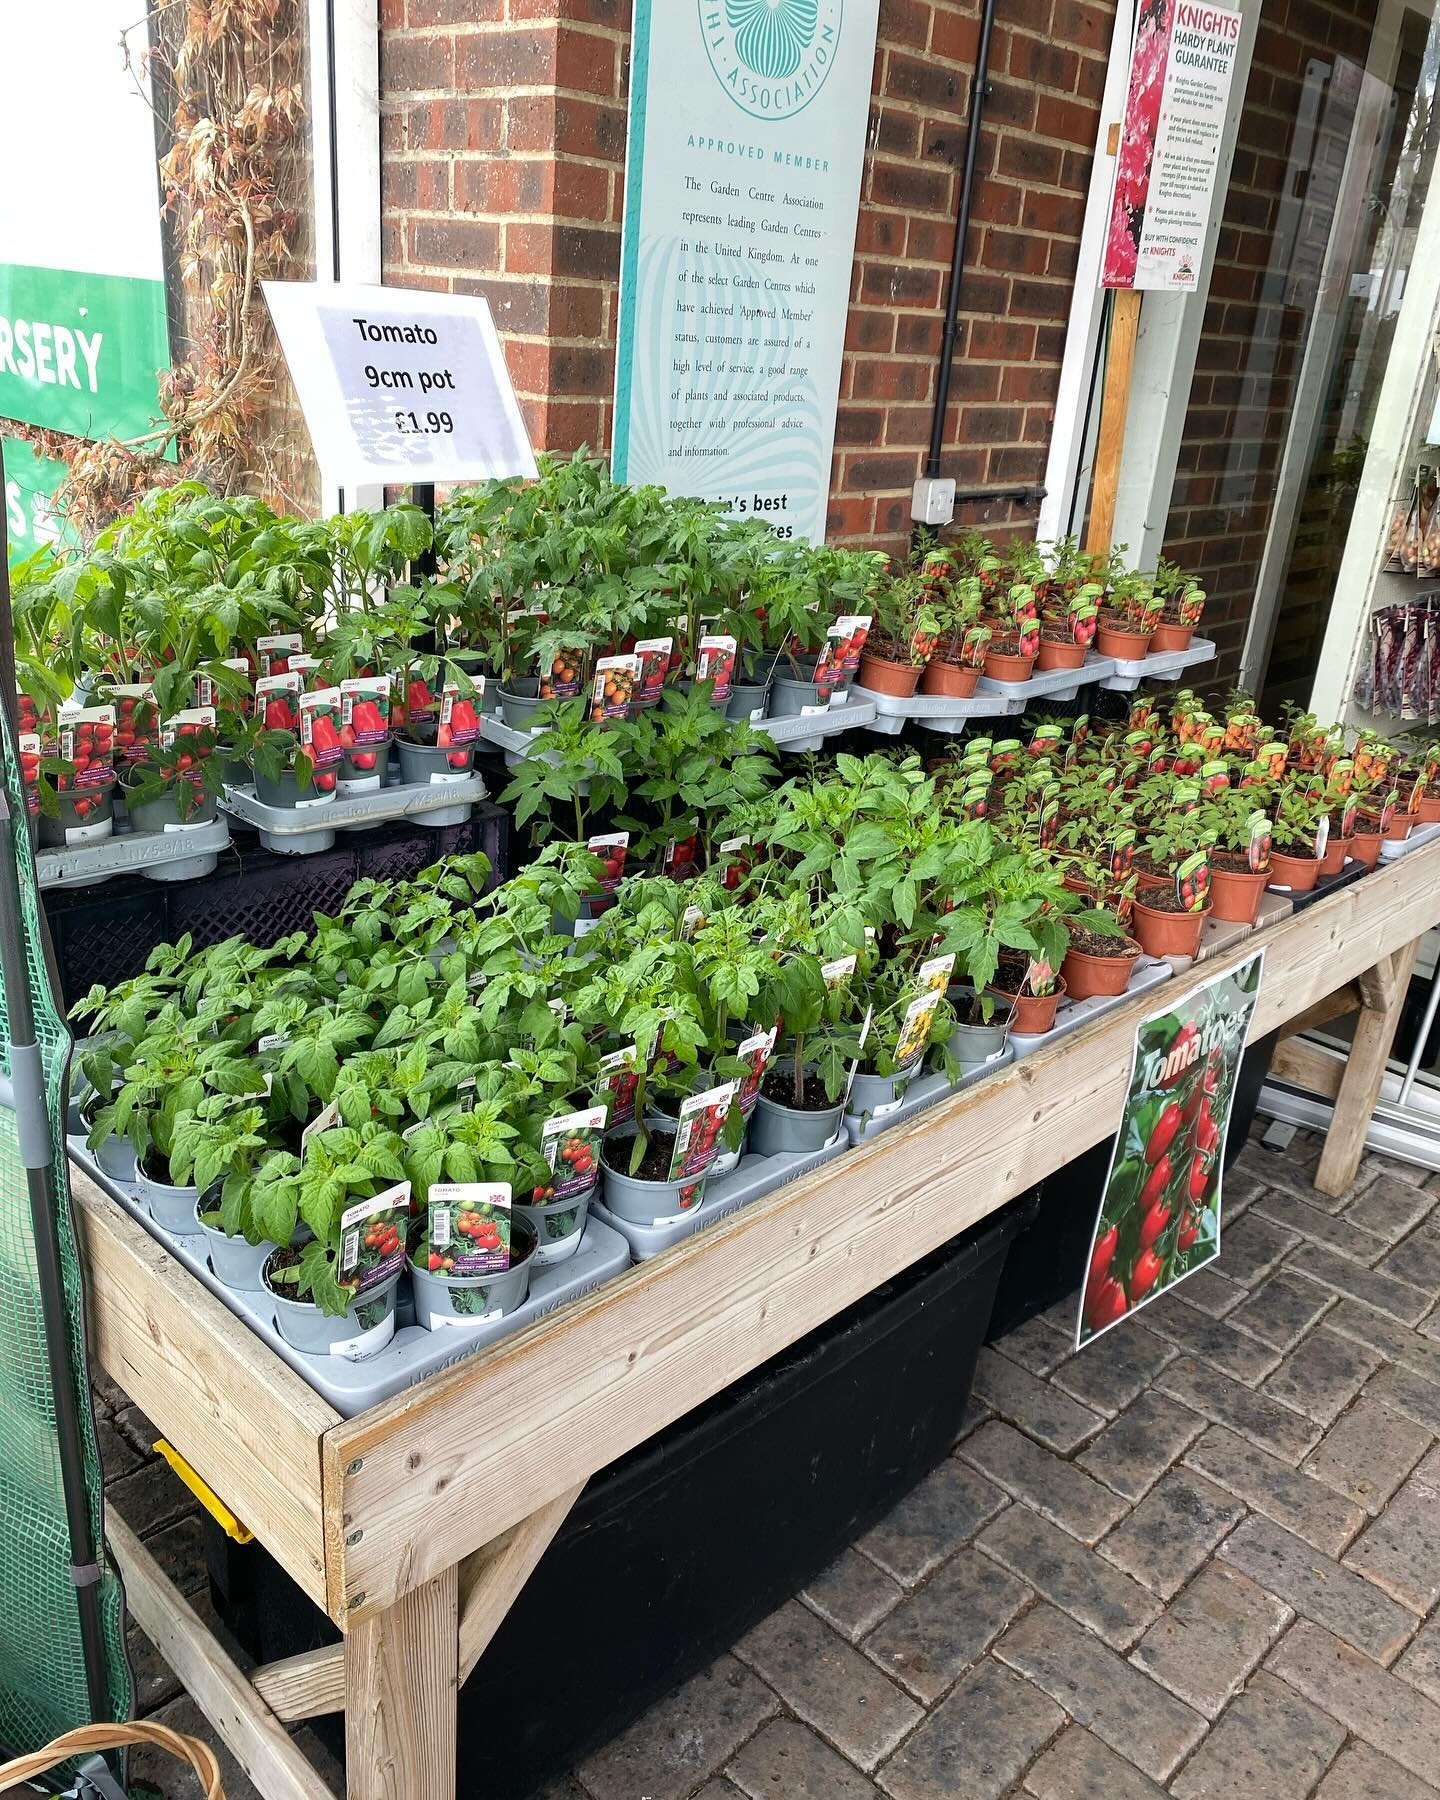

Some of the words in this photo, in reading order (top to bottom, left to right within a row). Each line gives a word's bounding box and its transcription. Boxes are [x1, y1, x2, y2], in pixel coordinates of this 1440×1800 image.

[1177, 3, 1239, 39] KNIGHTS
[1174, 29, 1206, 51] HARDY
[1206, 38, 1236, 58] PLANT
[727, 24, 834, 109] ASSOCIATION
[1175, 49, 1228, 74] GUARANTEE
[688, 134, 764, 160] APPROVED
[774, 151, 829, 172] MEMBER
[684, 176, 702, 190] The
[710, 180, 740, 197] Garden
[748, 186, 775, 202] Centre
[782, 192, 824, 210] Association
[682, 211, 722, 225] represents
[728, 214, 756, 233] leading
[760, 219, 788, 234] Garden
[794, 224, 821, 239] Centres
[1150, 247, 1176, 256] KNIGHTS
[1169, 236, 1198, 245] CONFIDENCE
[680, 239, 689, 252] in
[696, 241, 708, 254] the
[714, 243, 742, 258] United
[748, 248, 785, 264] Kingdom.
[790, 253, 800, 264] At
[805, 257, 819, 267] one
[678, 270, 689, 282] of
[692, 271, 704, 284] the
[708, 272, 728, 286] select
[732, 274, 760, 288] Garden
[764, 278, 791, 292] Centres
[795, 282, 816, 295] which
[1173, 273, 1195, 281] KNIGHTS
[676, 299, 695, 313] have
[700, 302, 734, 316] achieved
[740, 305, 776, 320] 'Approved
[781, 308, 813, 322] Member'
[352, 318, 438, 345] Tomato
[675, 333, 700, 344] status,
[705, 336, 742, 346] customers
[748, 338, 759, 346] are
[764, 336, 790, 348] assured
[794, 338, 802, 348] of
[806, 341, 811, 349] a
[364, 365, 414, 388] 9cm
[418, 368, 456, 394] pot
[673, 360, 690, 374] high
[696, 360, 712, 372] level
[716, 361, 726, 372] of
[730, 362, 754, 374] service,
[760, 366, 764, 374] a
[768, 364, 786, 378] good
[790, 367, 808, 378] range
[671, 388, 680, 400] of
[685, 388, 708, 404] plants
[713, 390, 728, 400] and
[733, 391, 768, 401] associated
[395, 411, 454, 434] £1.99
[670, 416, 702, 432] together
[710, 417, 726, 428] with
[733, 417, 776, 432] professional
[782, 418, 804, 428] advice
[668, 445, 682, 457] and
[684, 445, 730, 457] information.
[754, 494, 788, 512] best
[264, 1036, 284, 1044] TOMATO
[1141, 1003, 1249, 1094] Tomatoes
[347, 1204, 370, 1217] TOMATO
